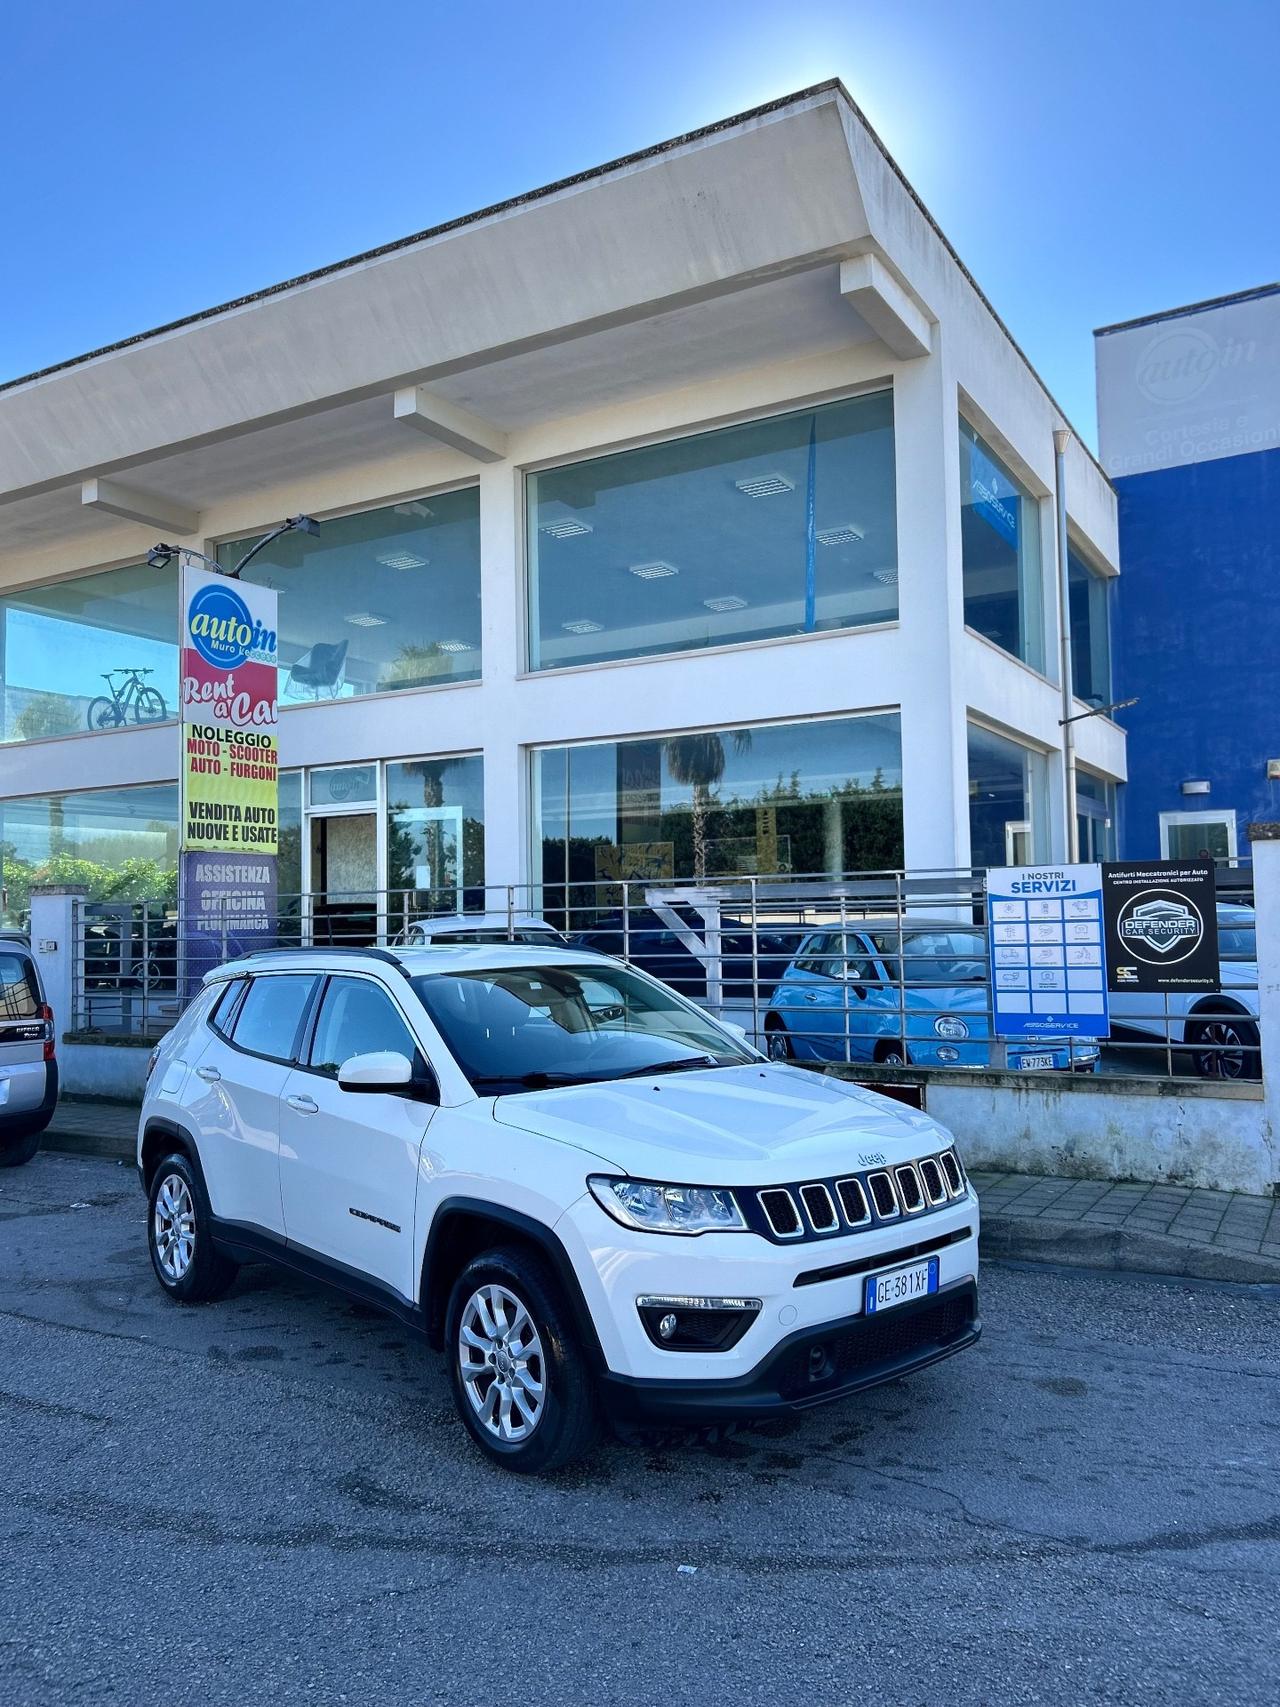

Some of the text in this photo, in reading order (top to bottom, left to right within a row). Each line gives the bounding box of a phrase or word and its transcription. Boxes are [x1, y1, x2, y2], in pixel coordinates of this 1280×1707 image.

[1145, 416, 1249, 447] Cortesia e
[1108, 444, 1172, 471] Grandi
[211, 640, 277, 663] Muro Leccese
[183, 673, 235, 704] Rent
[214, 700, 229, 718] a
[192, 725, 272, 748] NOLEGGIO
[187, 738, 221, 757] MOTO
[229, 744, 278, 764] SCOOTER
[190, 757, 221, 774] AUTO
[230, 762, 277, 781] FURGONI
[189, 802, 275, 824] VENDITA AUTO
[187, 822, 277, 843] NUOVE E USATE
[195, 864, 270, 883] ASSISTENZA
[1027, 872, 1064, 880] NOSTRI
[1136, 870, 1178, 878] Meccatronici
[1011, 880, 1076, 894] SERVIZI
[201, 890, 266, 911] OFFICINA
[1125, 920, 1195, 928] DEFENDER
[857, 1151, 887, 1167] Jeep
